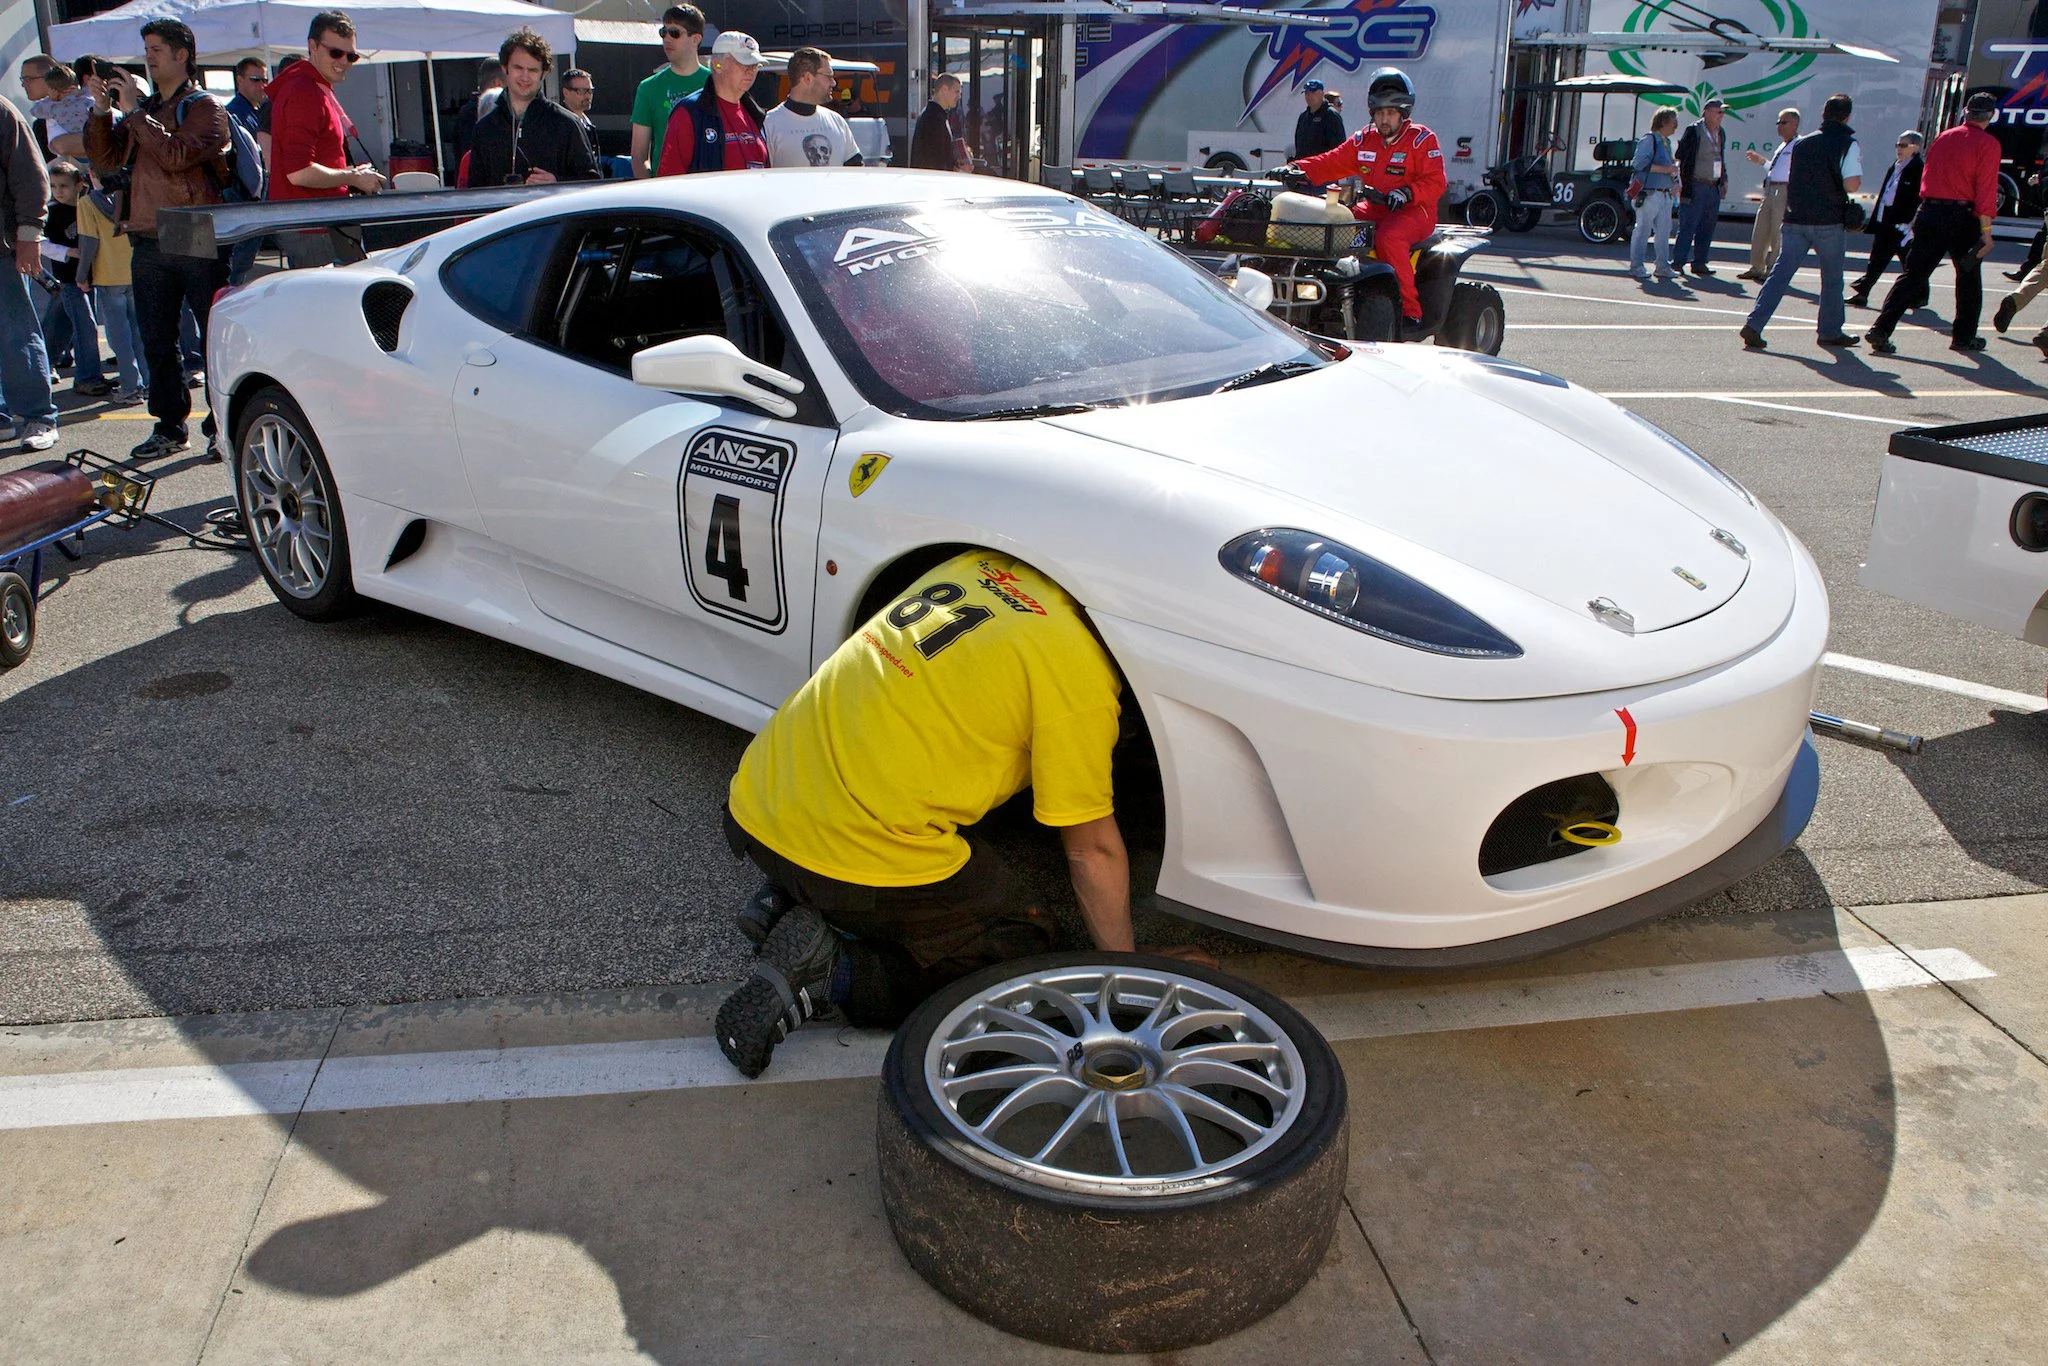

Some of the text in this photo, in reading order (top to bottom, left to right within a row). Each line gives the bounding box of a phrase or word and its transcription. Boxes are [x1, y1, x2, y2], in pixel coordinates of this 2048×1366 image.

[774, 20, 893, 39] PORSCHE
[1552, 182, 1575, 203] 36
[693, 437, 780, 475] ANSA
[689, 463, 776, 490] MOTORSPORTS
[705, 493, 750, 603] 4
[977, 578, 1034, 613] Speed
[886, 581, 996, 661] 81
